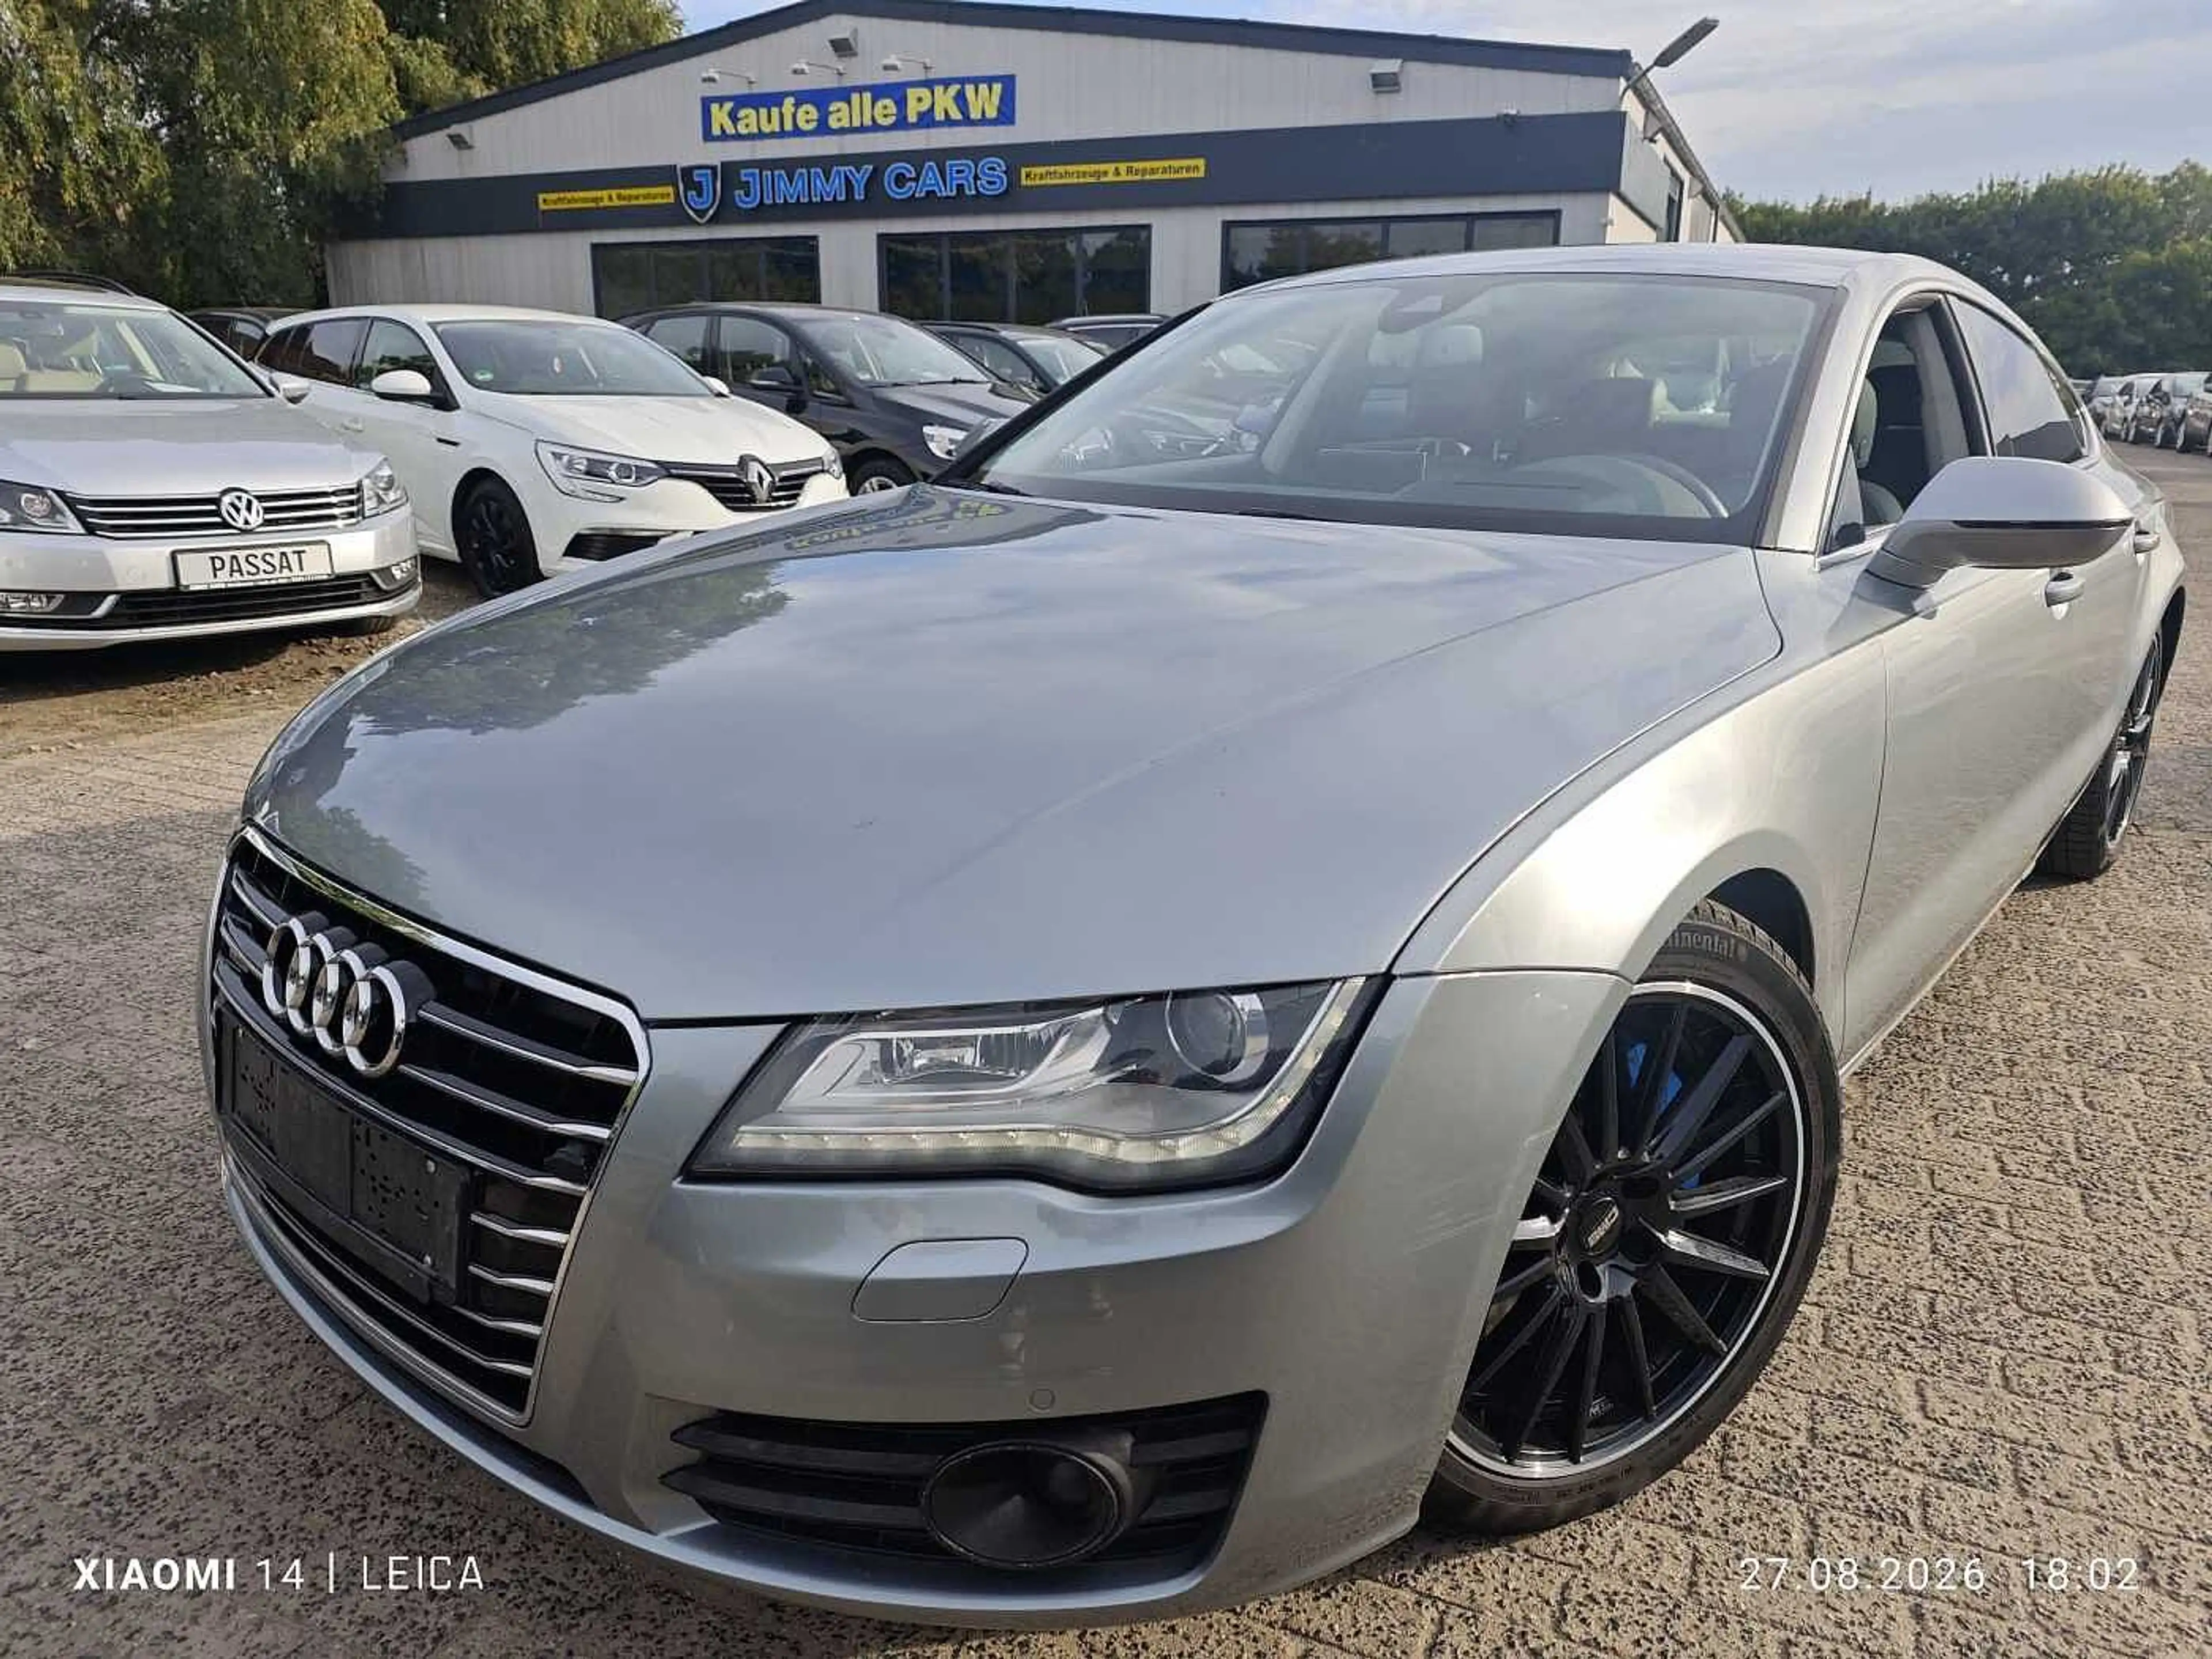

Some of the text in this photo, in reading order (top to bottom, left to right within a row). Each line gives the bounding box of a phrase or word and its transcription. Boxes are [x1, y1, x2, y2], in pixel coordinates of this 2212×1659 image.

[710, 82, 1002, 135] Kaufe alle PKW
[687, 169, 714, 210] J
[734, 157, 1008, 209] JIMMY CARS
[1025, 163, 1200, 181] Kraftfahrzeuge & Reparaturen
[209, 550, 307, 579] PASSAT
